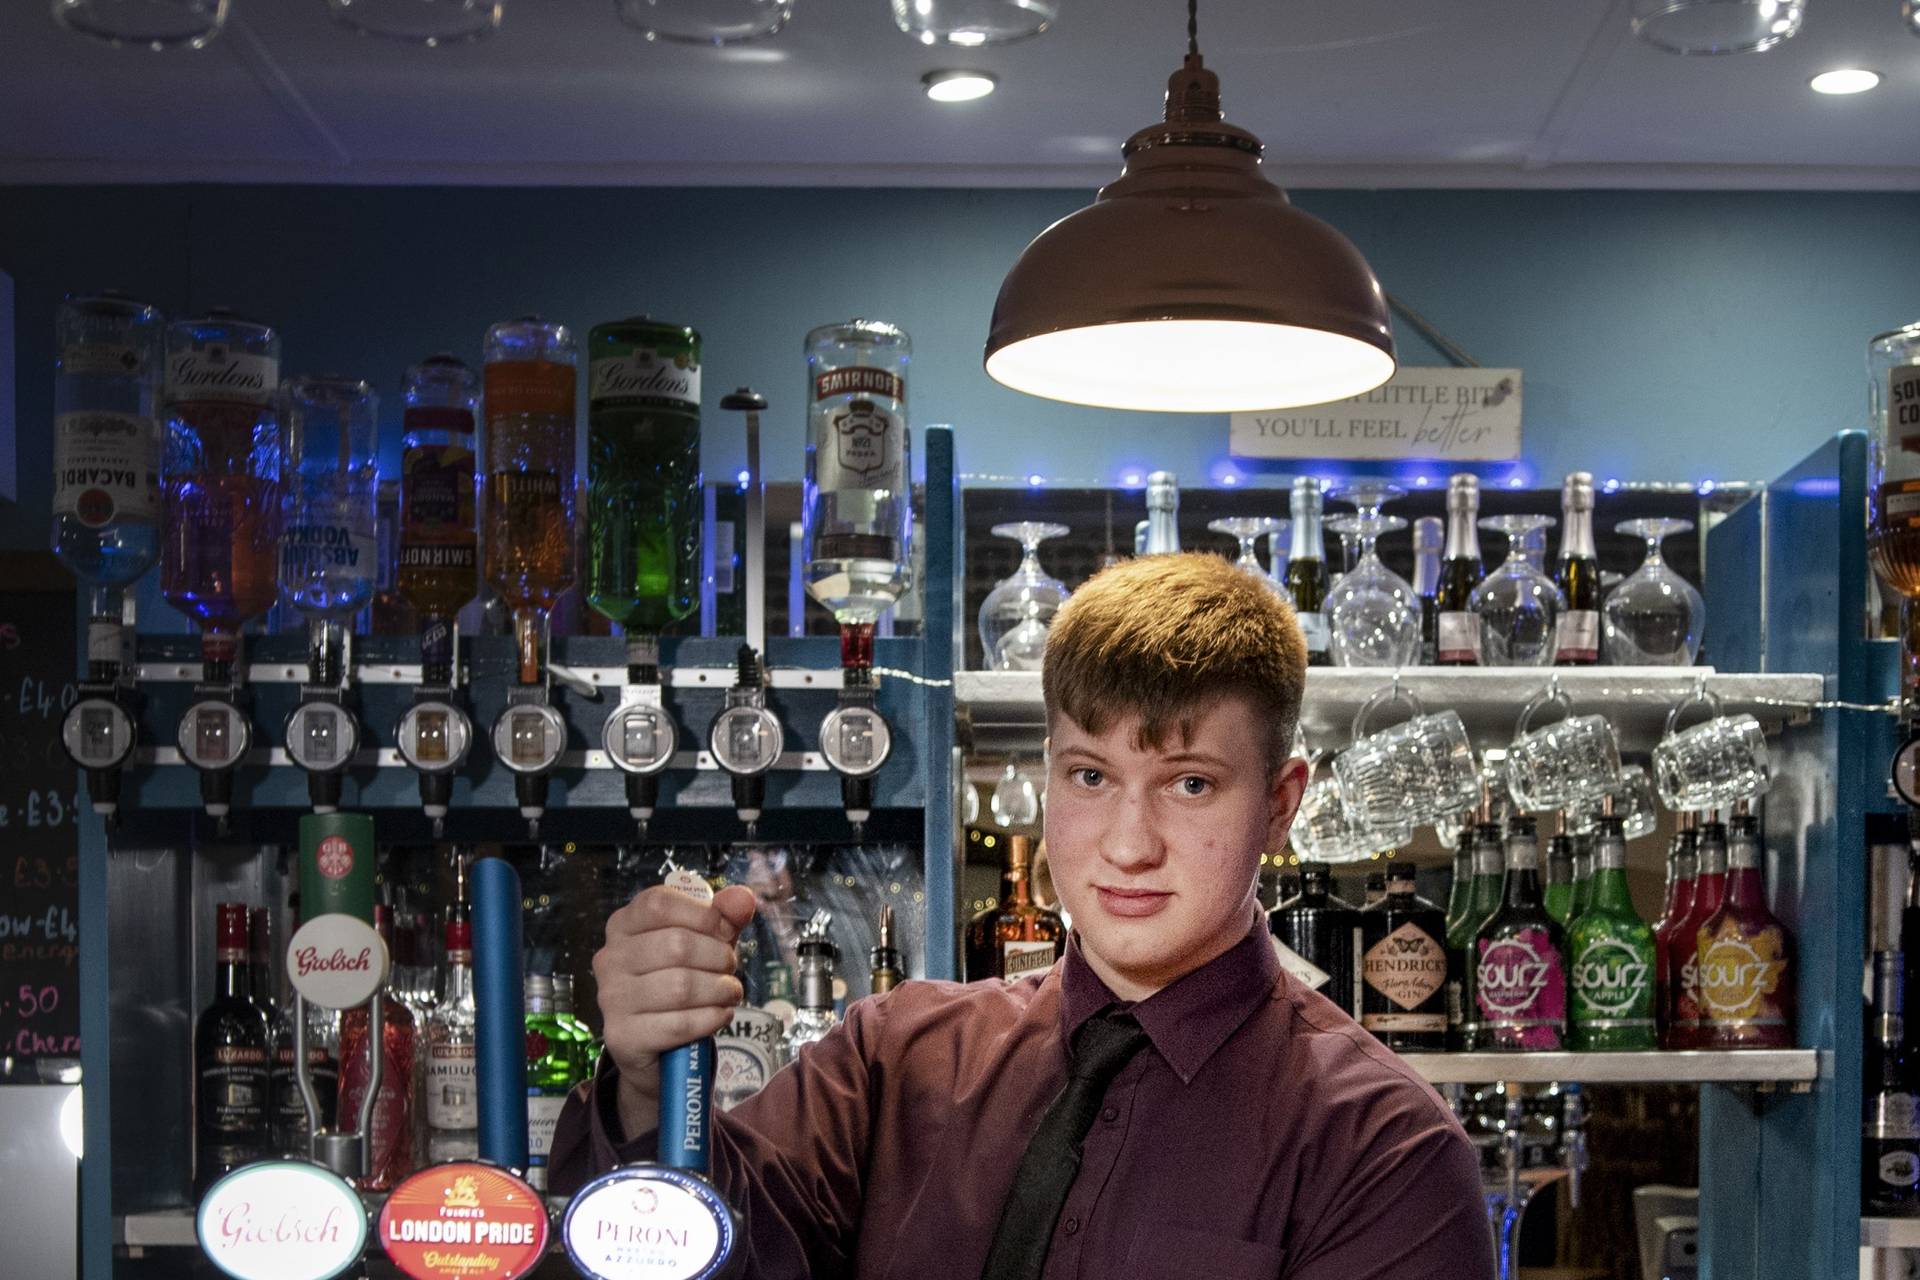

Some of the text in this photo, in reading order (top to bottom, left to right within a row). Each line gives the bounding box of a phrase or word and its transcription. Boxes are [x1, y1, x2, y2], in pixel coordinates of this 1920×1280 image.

[173, 357, 264, 389] Gordon's
[600, 362, 689, 394] Gordon's
[821, 371, 898, 395] SMIRNOFF
[1368, 386, 1449, 405] LITTLE
[1256, 402, 1492, 453] YOU'LL FEEL better
[297, 946, 371, 976] Grolsch
[1594, 991, 1626, 1000] APPLE
[279, 1048, 326, 1061] LUDO
[689, 1042, 700, 1071] NAS
[684, 1075, 702, 1151] PERONI
[389, 1220, 535, 1245] LONDON PRIDE
[596, 1219, 689, 1248] PERONI
[423, 1251, 500, 1270] Outstanding
